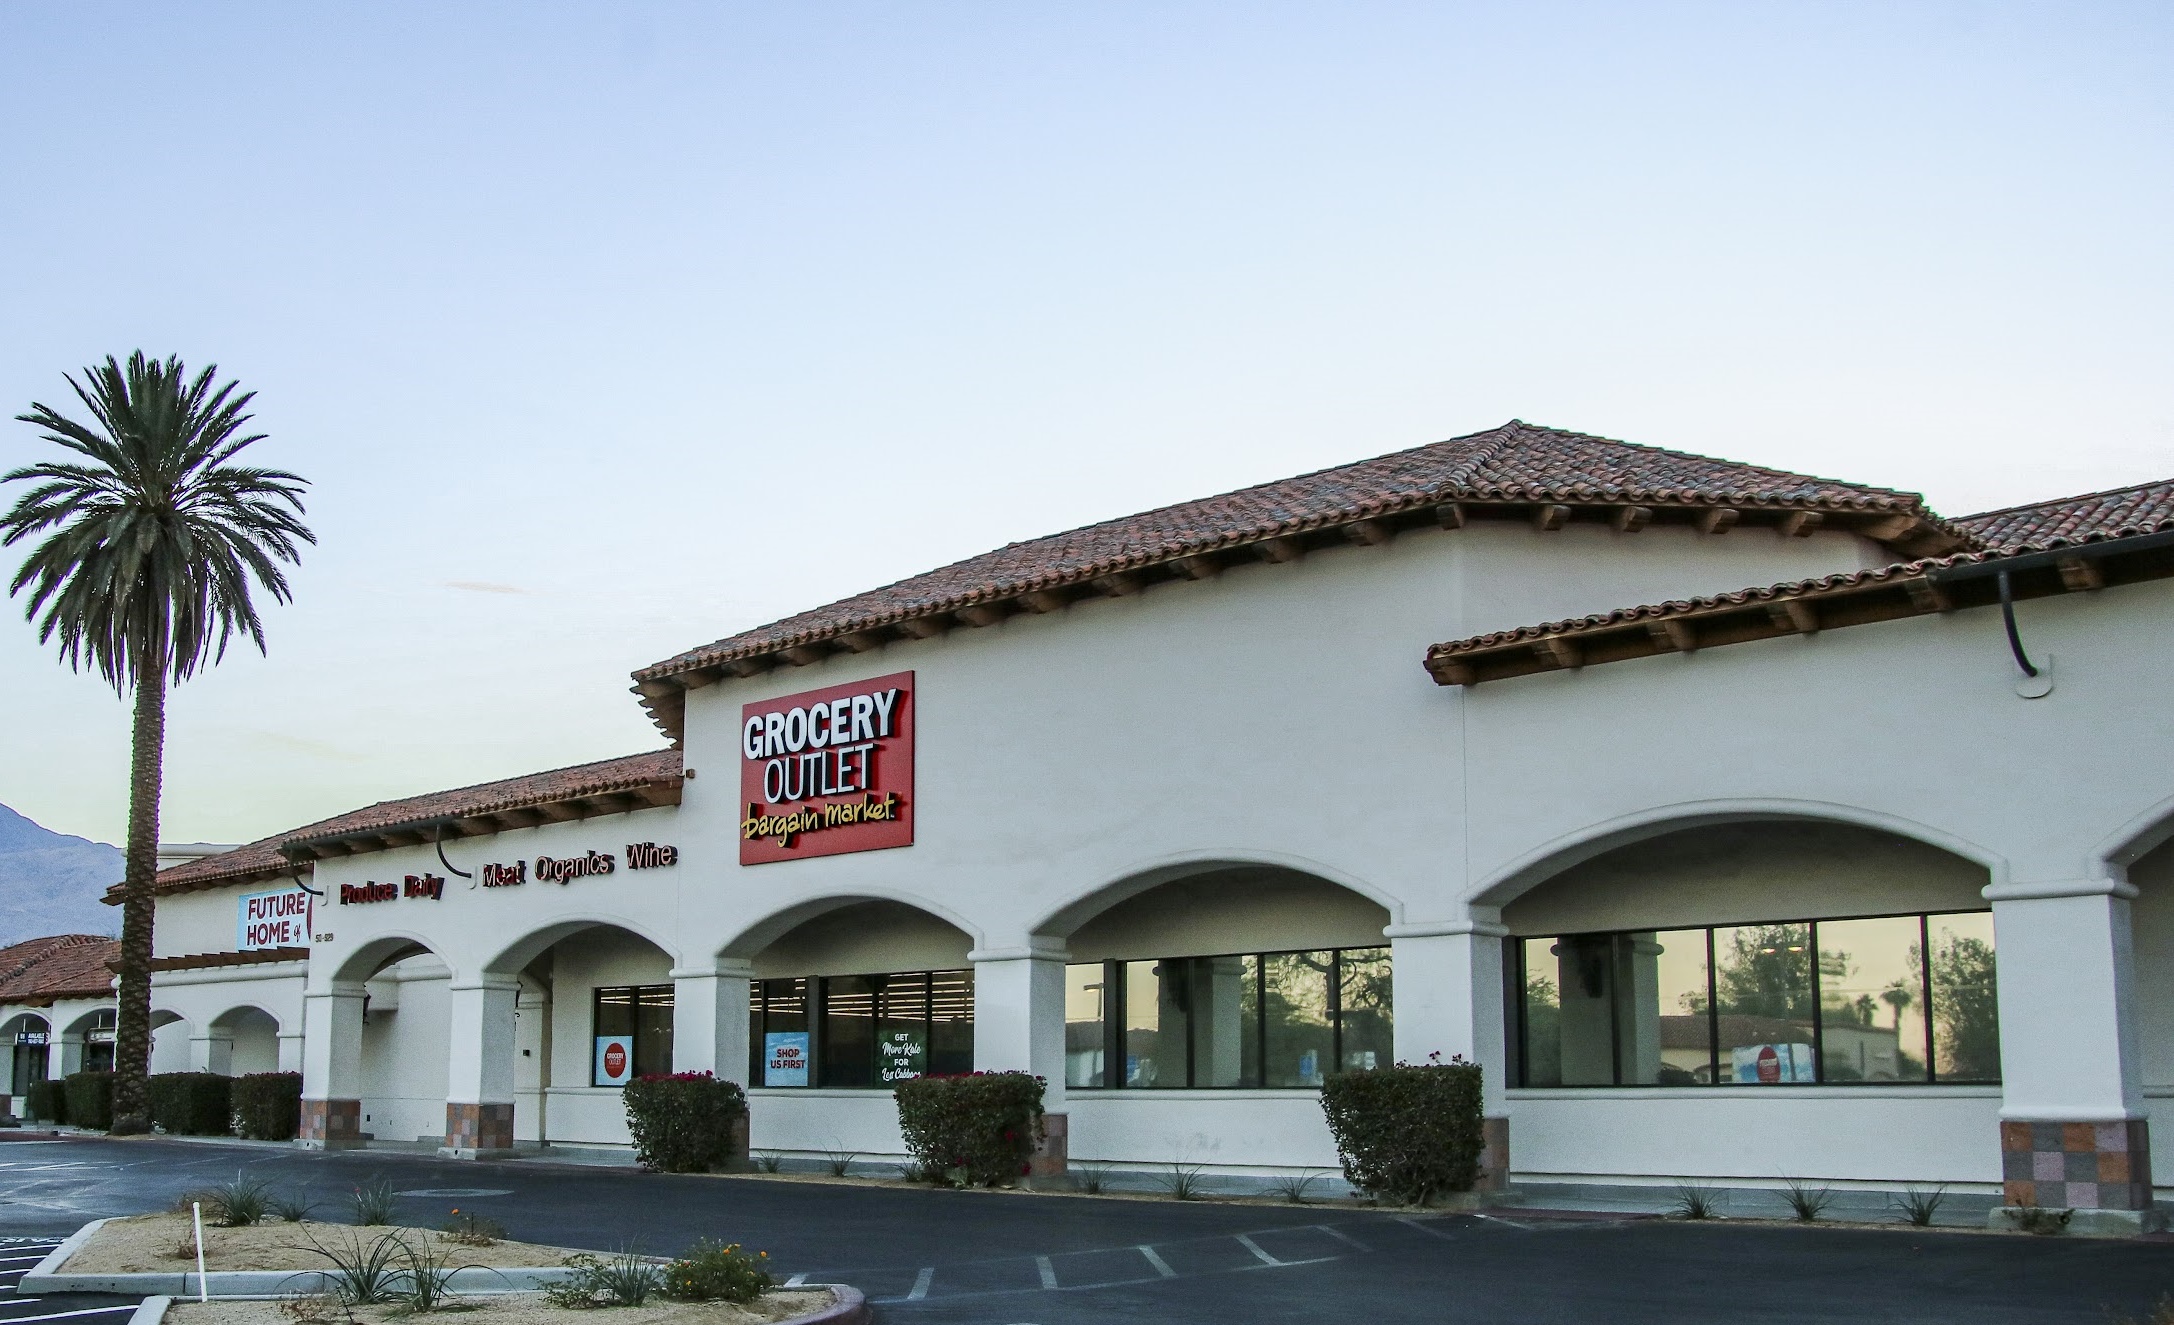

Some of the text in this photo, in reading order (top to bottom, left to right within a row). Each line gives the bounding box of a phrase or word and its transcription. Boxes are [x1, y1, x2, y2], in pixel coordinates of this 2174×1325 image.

[743, 688, 897, 760] GROCERY
[764, 743, 874, 804] OUTLET
[741, 792, 895, 848] bargain market
[340, 842, 678, 905] Produce Dairy Meat Organics Wine
[248, 892, 306, 920] FUTURE
[247, 921, 290, 946] HOME
[882, 1041, 921, 1056] More Kale
[895, 1033, 909, 1041] GET
[770, 1060, 806, 1069] US FIRST
[776, 1048, 800, 1058] SHOP
[894, 1058, 909, 1066] FOR
